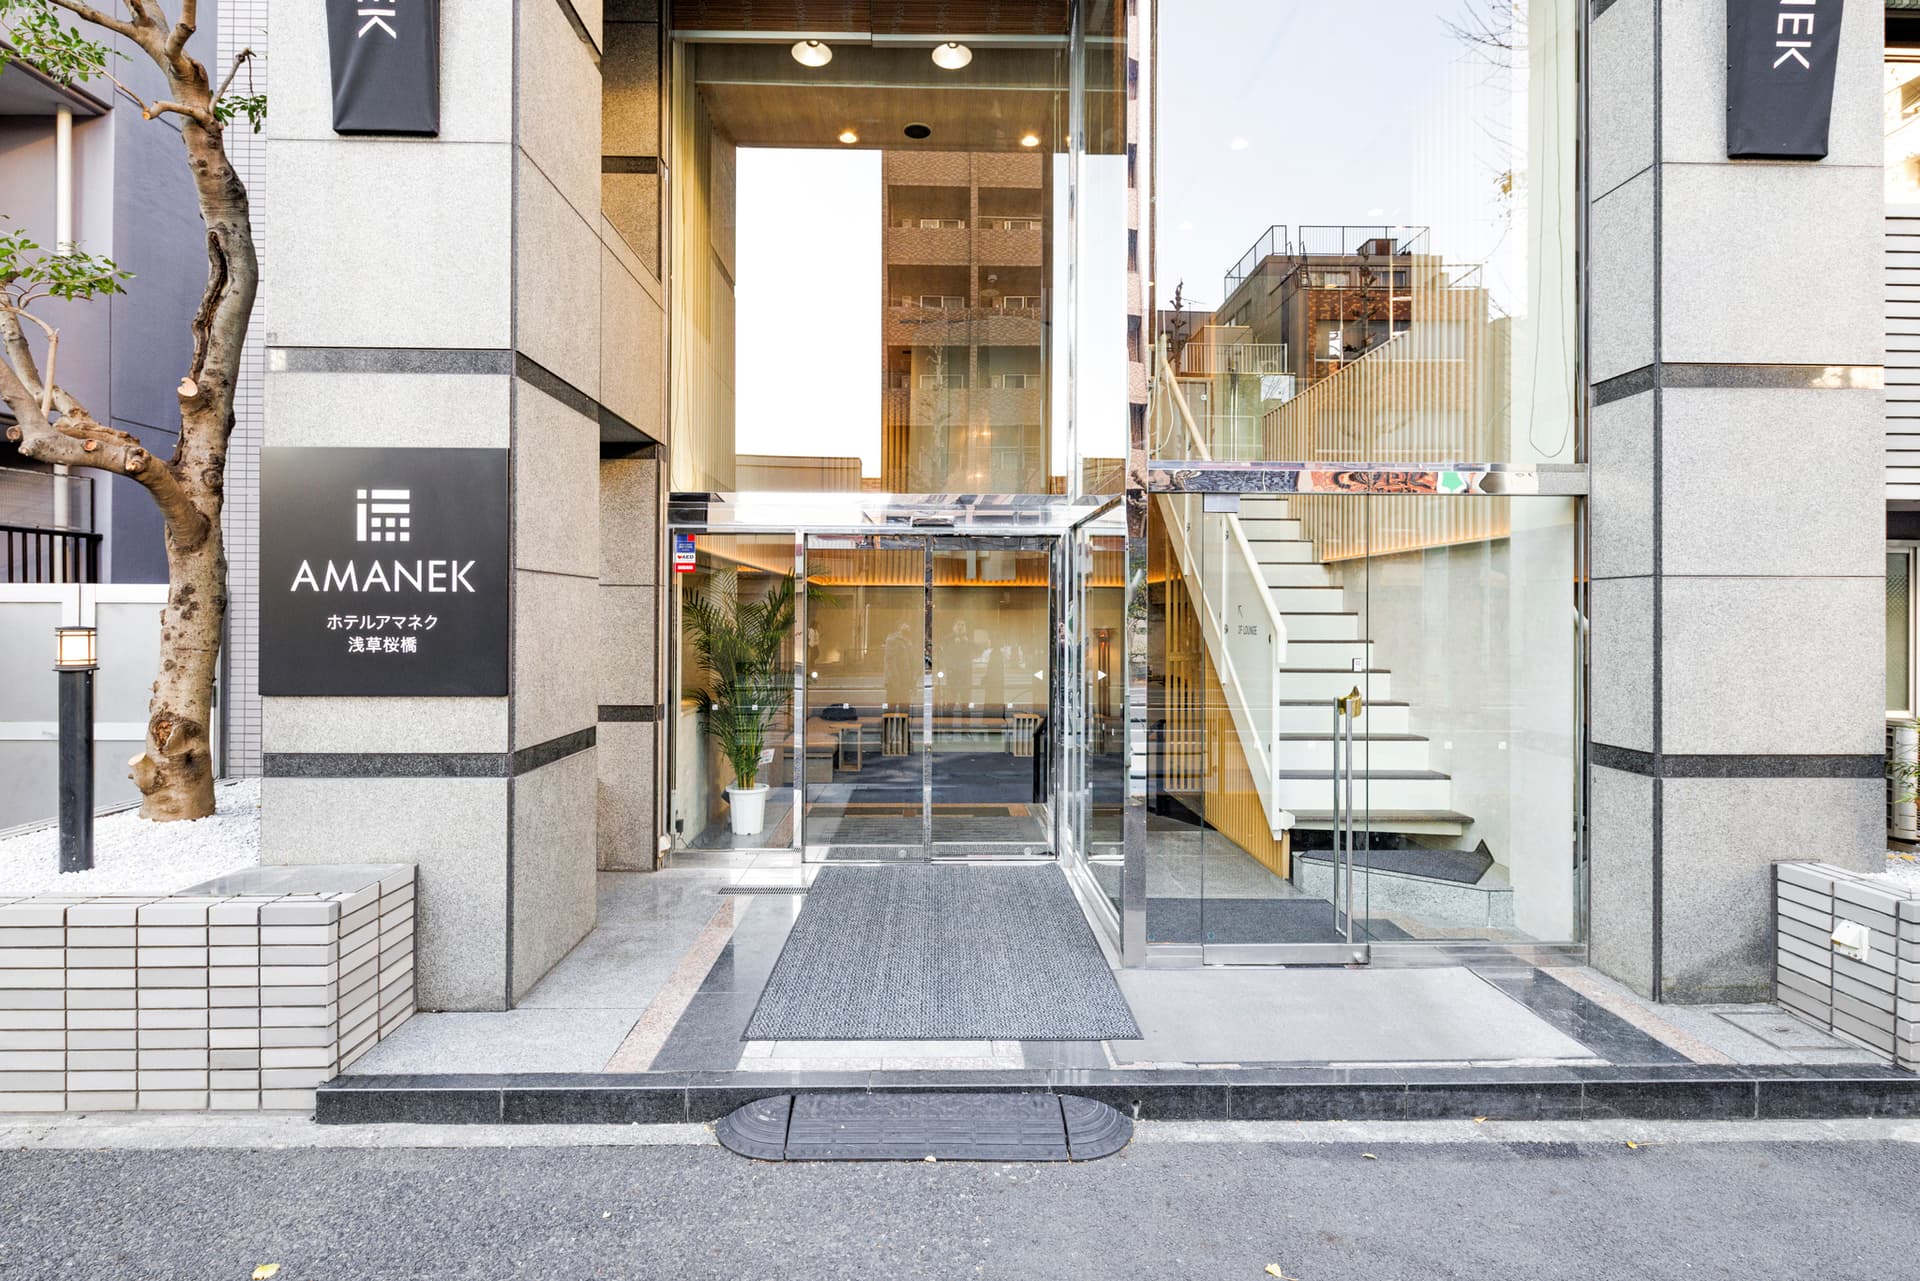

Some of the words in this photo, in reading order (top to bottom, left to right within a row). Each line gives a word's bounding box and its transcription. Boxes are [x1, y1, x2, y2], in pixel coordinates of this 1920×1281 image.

[357, 0, 397, 39] K
[1772, 0, 1817, 69] EK
[290, 559, 476, 593] AMANEK
[326, 614, 438, 631] ホテルアマネク
[347, 635, 417, 653] 浅草桜橋
